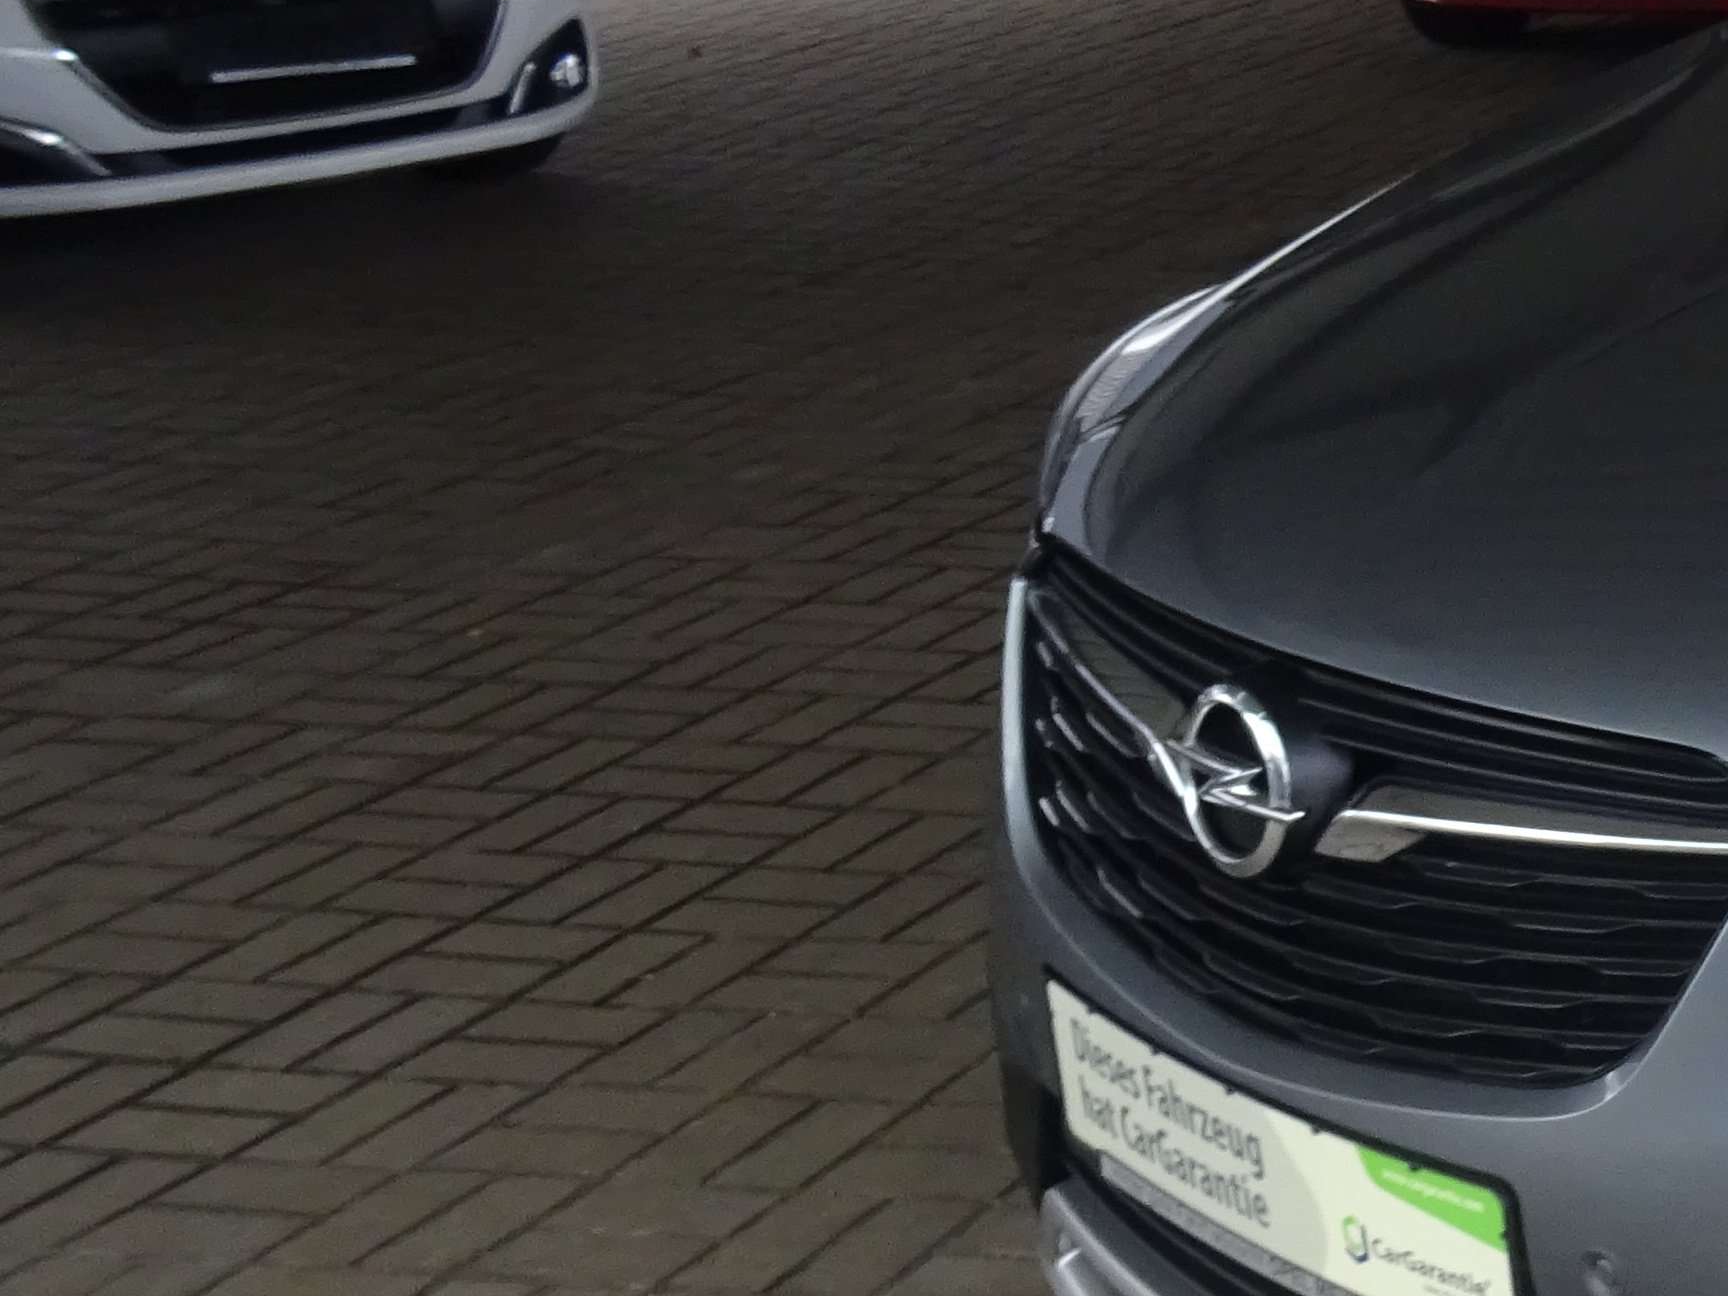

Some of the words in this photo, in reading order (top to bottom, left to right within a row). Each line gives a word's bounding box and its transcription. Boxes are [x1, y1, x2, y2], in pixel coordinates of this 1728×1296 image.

[1078, 1074, 1118, 1139] hat
[1120, 1105, 1271, 1230] CarGarantie
[1142, 1064, 1265, 1181] Fahrzeug
